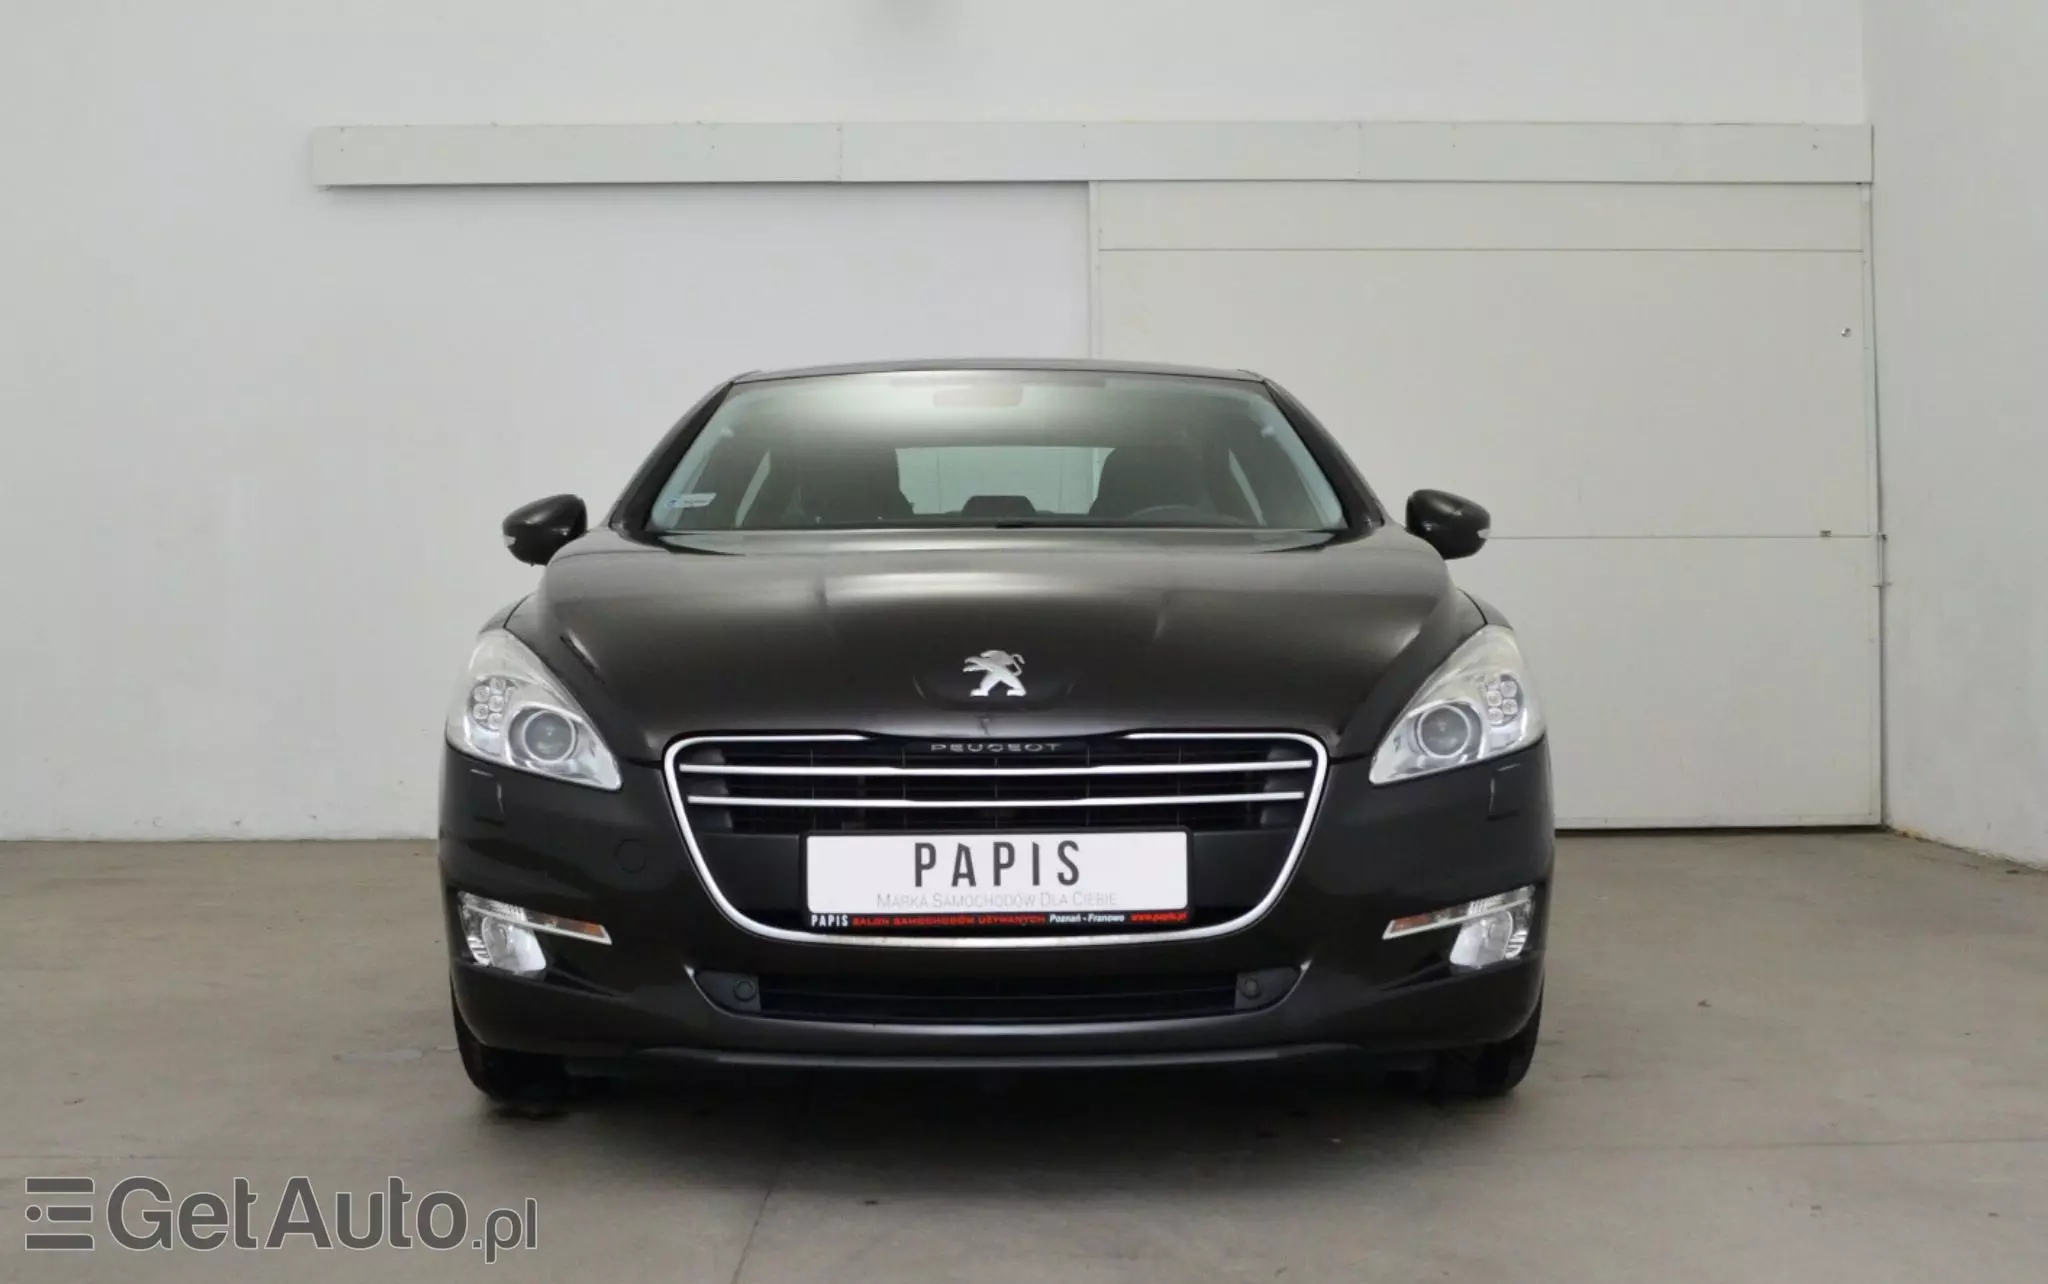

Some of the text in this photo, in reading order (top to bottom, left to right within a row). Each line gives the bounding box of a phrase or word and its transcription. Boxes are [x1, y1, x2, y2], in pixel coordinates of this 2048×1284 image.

[930, 743, 1061, 752] PEUGEOT
[914, 840, 1080, 888] PAPIS
[876, 893, 927, 909] MARKA
[1040, 891, 1068, 907] DLA
[1072, 890, 1118, 907] CIEBIE
[811, 914, 849, 927] PAPIS
